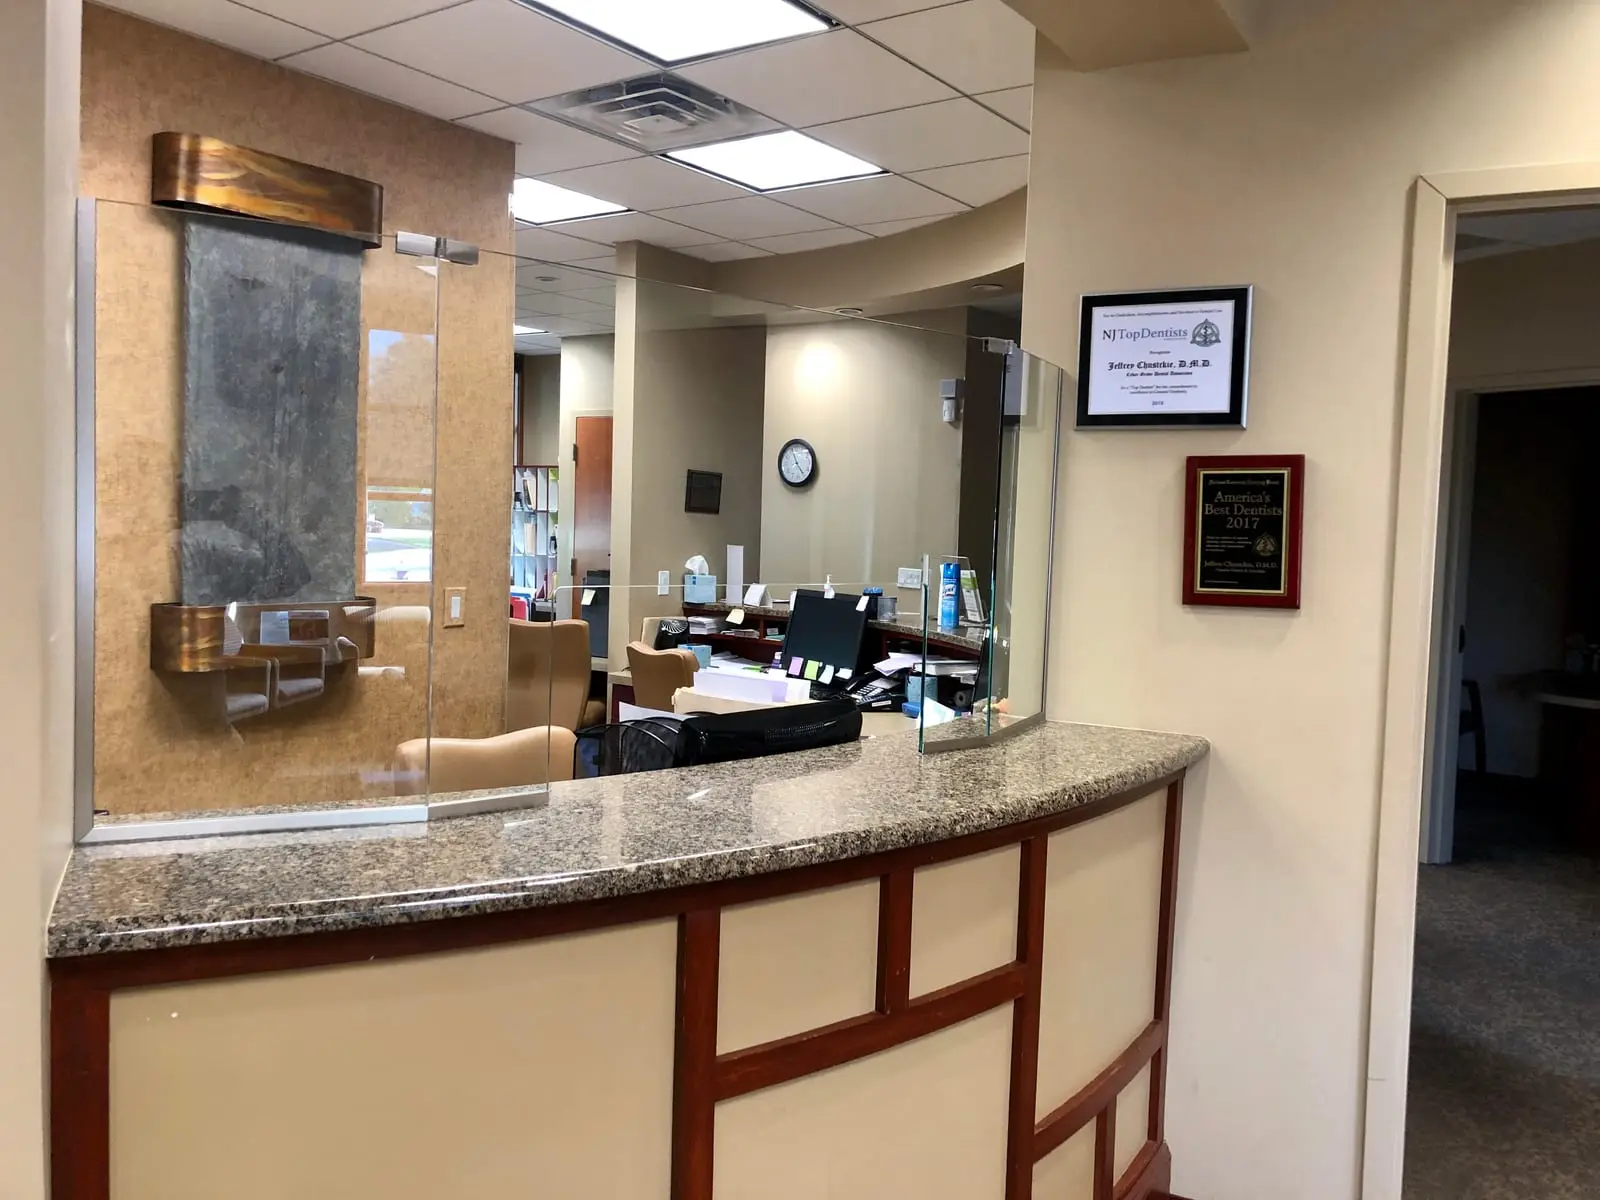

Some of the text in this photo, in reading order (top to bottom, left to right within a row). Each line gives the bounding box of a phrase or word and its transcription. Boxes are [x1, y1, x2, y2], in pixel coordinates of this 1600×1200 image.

[1107, 361, 1135, 371] Jeffrey
[1178, 359, 1212, 368] D.M.D.
[1214, 490, 1272, 503] America's
[1204, 503, 1282, 516] Best Dentists
[1225, 516, 1260, 529] 2017
